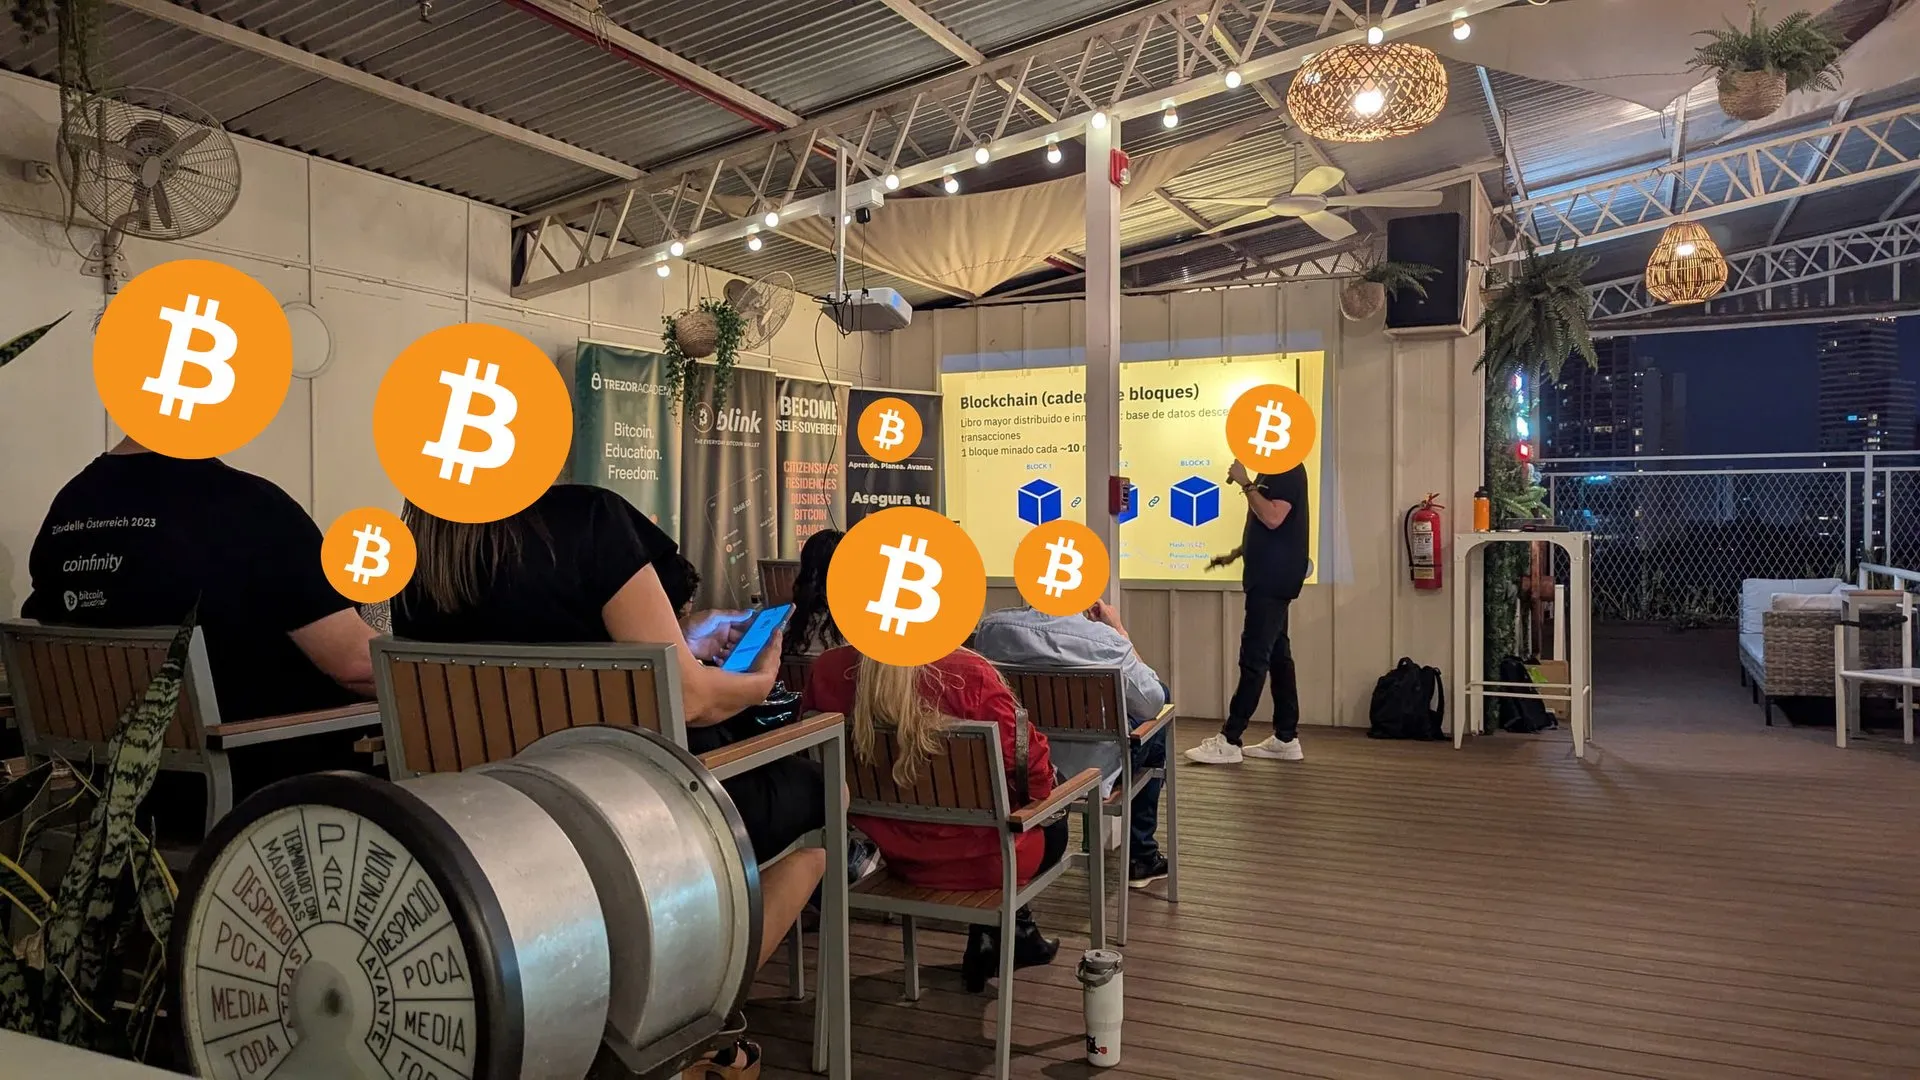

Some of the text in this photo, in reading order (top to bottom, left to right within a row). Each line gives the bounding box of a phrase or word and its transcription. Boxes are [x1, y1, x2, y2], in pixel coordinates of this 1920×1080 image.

[960, 392, 1038, 410] Blockchain
[1041, 390, 1086, 407] (cade
[1129, 383, 1199, 403] bloques)
[780, 395, 838, 421] BECOME
[961, 415, 982, 428] Libro
[984, 416, 1012, 428] mayor
[1014, 413, 1062, 425] distribuido
[1126, 411, 1149, 420] base
[1152, 409, 1165, 419] de
[1167, 408, 1196, 418] datos
[614, 421, 655, 439] Bitcoin.
[716, 407, 762, 434] blink
[775, 419, 842, 436] SELF-SOVEREIGN
[961, 432, 1021, 443] transacciones
[605, 442, 663, 460] Education.
[961, 448, 967, 457] 1
[968, 446, 999, 458] bloque
[1000, 445, 1034, 456] minado
[1035, 444, 1058, 453] cada
[1060, 443, 1080, 453] ~10
[608, 464, 659, 481] Freedom.
[783, 461, 839, 474] CITIZENSHIPS
[907, 463, 933, 471] Avanza.
[785, 476, 837, 490] RESIDENCIES
[791, 493, 831, 505] BUSINESS
[851, 491, 931, 507] Asegura tu
[86, 516, 128, 529] Österreich
[131, 517, 156, 527] 2023
[794, 508, 827, 520] BITCOIN
[63, 553, 123, 572] coinfinity
[79, 590, 103, 600] bitcoin
[283, 825, 319, 921] TERMINADO CON
[317, 823, 345, 912] PARA
[262, 836, 306, 922] MAQUINAS
[353, 840, 398, 932] ATENCION
[231, 864, 293, 946] DESPACIO
[376, 878, 440, 957] DESPACIO
[215, 921, 267, 973] POCA
[403, 945, 465, 989] POCA
[211, 986, 269, 1023] MEDIA
[365, 957, 391, 1050] AVANTE
[404, 1010, 466, 1057] MEDIA
[224, 1034, 280, 1080] TODA
